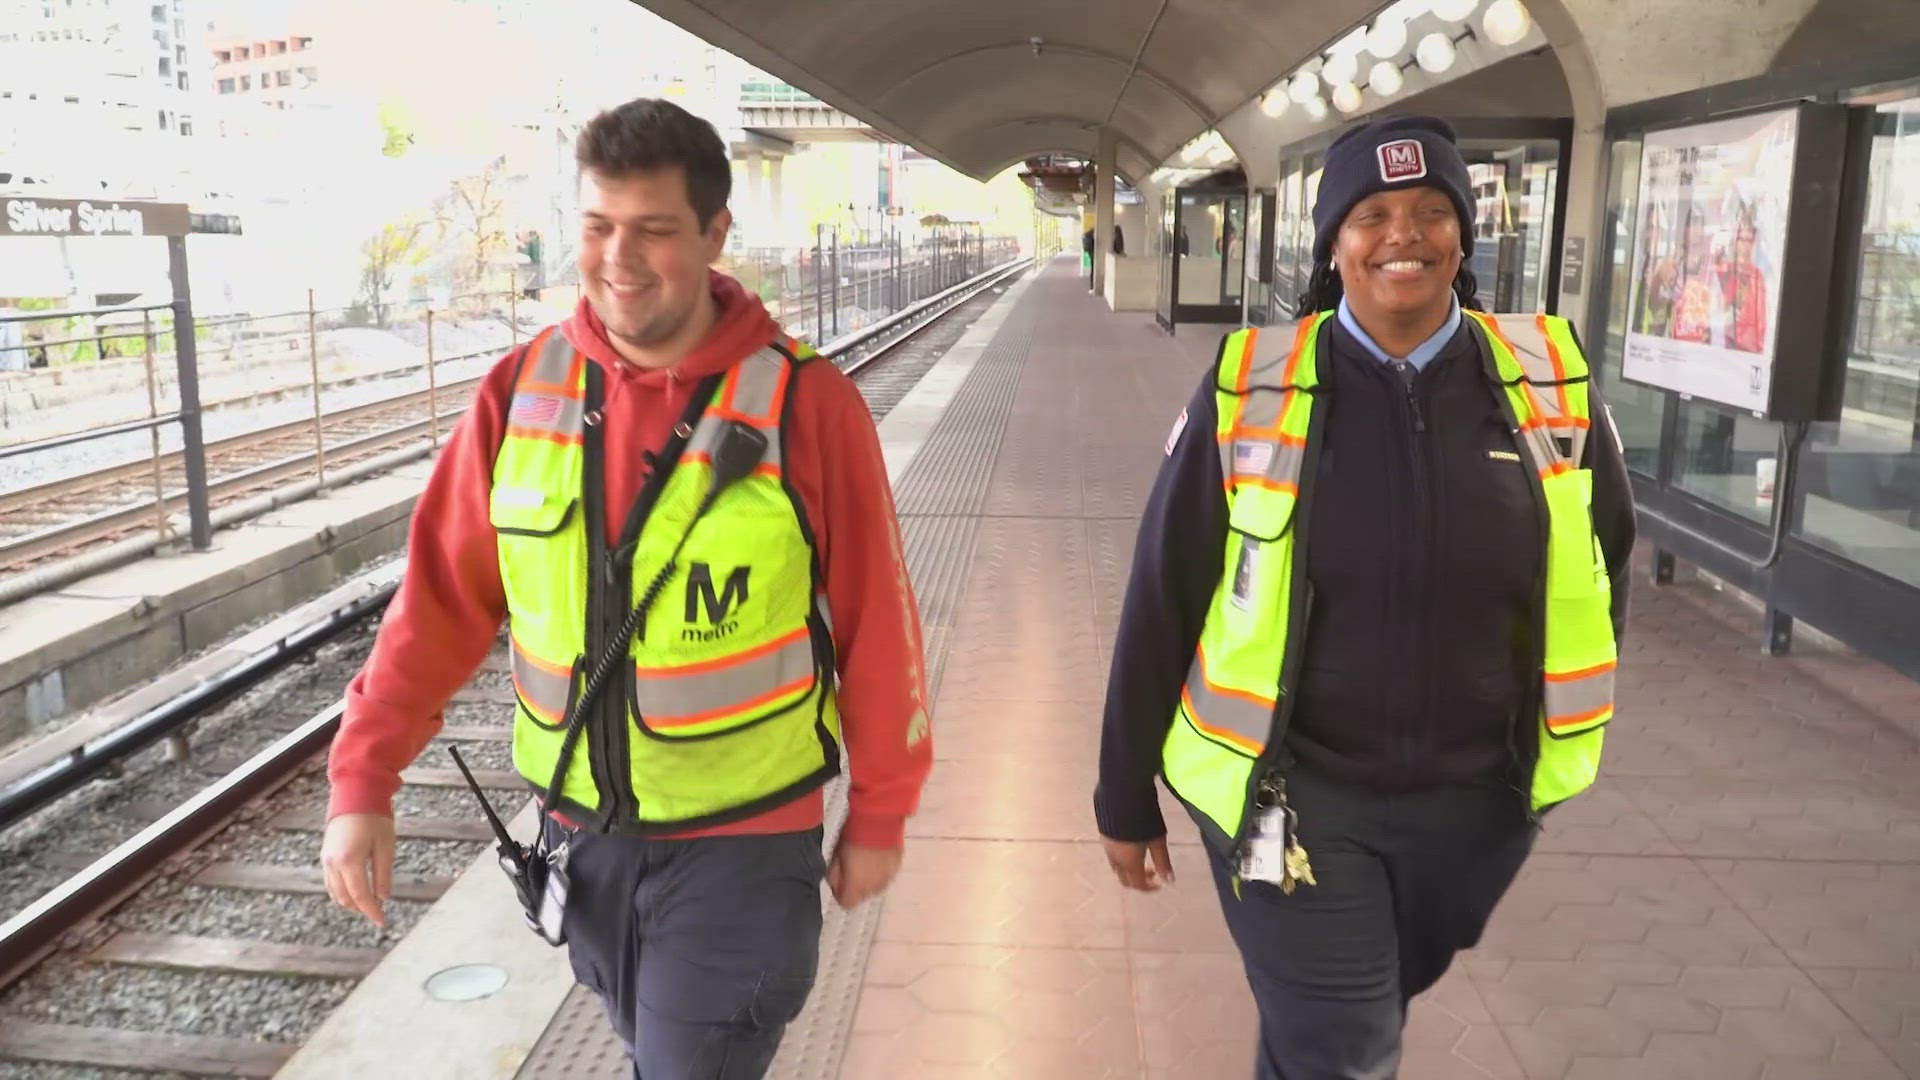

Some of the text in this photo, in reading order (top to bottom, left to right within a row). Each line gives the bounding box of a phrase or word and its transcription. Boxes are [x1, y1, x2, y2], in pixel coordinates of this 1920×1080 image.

[1387, 145, 1416, 165] M
[7, 200, 143, 236] Silver Spring
[685, 562, 751, 624] M
[682, 620, 739, 641] metro
